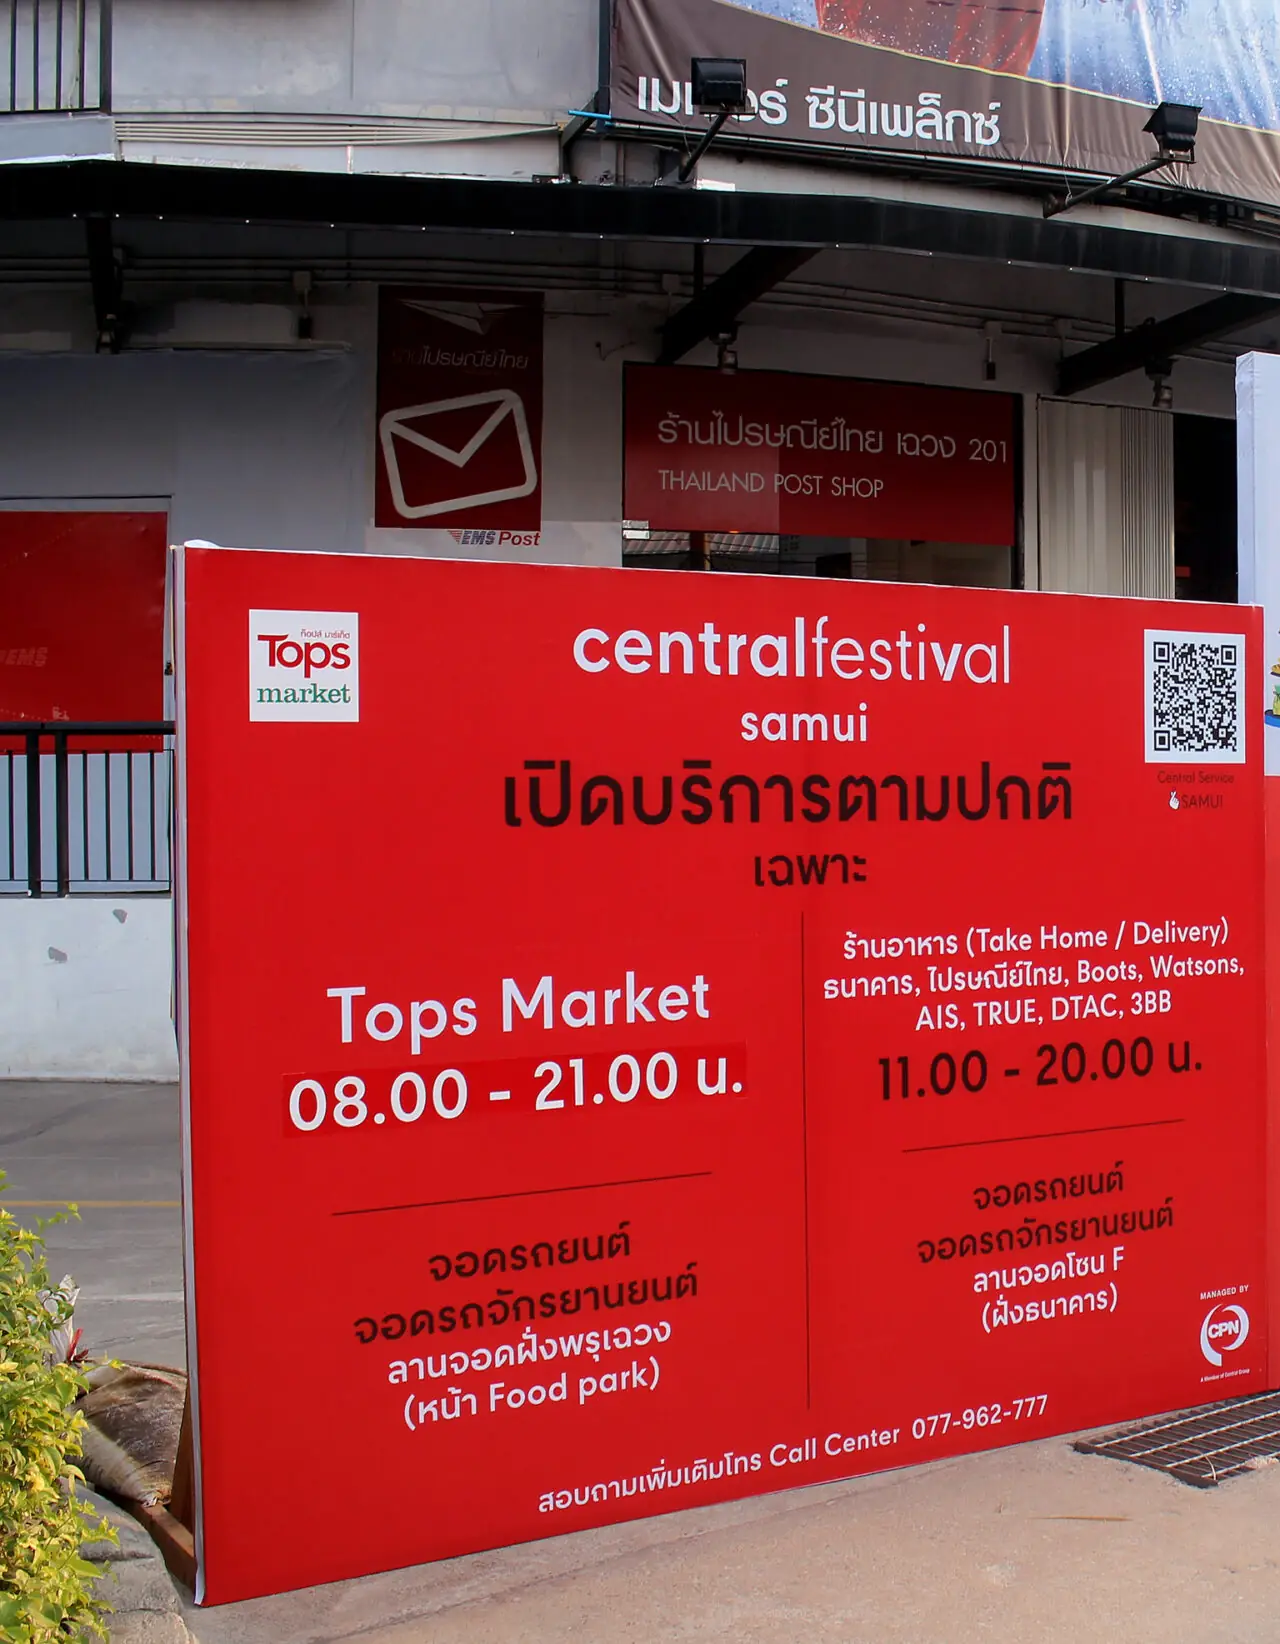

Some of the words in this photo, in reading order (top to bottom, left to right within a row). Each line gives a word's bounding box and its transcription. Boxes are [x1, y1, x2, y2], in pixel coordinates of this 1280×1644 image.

[806, 86, 1001, 146] ซีนีเพล็กซ์
[657, 410, 884, 454] ร้านไปรษณีย์ไทย
[897, 432, 957, 459] เฉวง
[968, 438, 1008, 465] 201
[658, 469, 765, 493] THAILAND
[773, 473, 824, 496] POST
[831, 475, 885, 499] SHOP
[461, 531, 496, 545] EMS
[498, 531, 541, 546] Post
[5, 646, 48, 668] EMS
[257, 633, 351, 679] Tops
[573, 616, 1011, 684] centralfestival
[257, 683, 351, 703] market
[741, 702, 868, 742] samui
[503, 759, 1072, 827] เปิดบริการตามปกติ
[1157, 771, 1195, 784] Central
[1198, 771, 1235, 784] Service
[1181, 794, 1223, 809] SAMUI
[754, 852, 866, 887] เฉพาะ
[843, 930, 957, 961] ร้านอาหาร
[966, 926, 1033, 958] (Take
[1040, 924, 1108, 950] Home
[1133, 915, 1230, 947] Delivery)
[824, 973, 921, 1001] ธนาคาร,
[928, 959, 1069, 995] ไปรษณีย์ไทย,
[1077, 958, 1143, 986] Boots,
[1150, 954, 1246, 979] Watsons,
[327, 985, 477, 1055] Tops
[502, 971, 710, 1033] Market
[915, 1003, 966, 1032] AIS,
[973, 997, 1043, 1027] TRUE,
[1051, 993, 1124, 1021] DTAC,
[1130, 989, 1172, 1014] 3BB
[288, 1068, 468, 1132] 08.00
[490, 1090, 511, 1101] -
[534, 1051, 678, 1111] 21.00
[697, 1057, 743, 1096] น.
[878, 1049, 988, 1100] 11.00
[1036, 1036, 1154, 1087] 20.00
[1167, 1039, 1203, 1073] น.
[973, 1160, 1125, 1211] จอดรถยนต์
[428, 1220, 631, 1282] จอดรถยนต์
[917, 1197, 1175, 1264] จอดรถจักรยานยนต์
[972, 1251, 1106, 1293] ลานจอดโซน
[1112, 1246, 1125, 1271] F
[1200, 1286, 1237, 1300] MANAGED
[1239, 1284, 1249, 1293] BY
[353, 1261, 699, 1345] จอดรถจักรยานยนต์
[981, 1282, 1119, 1333] (ฝั่งธนาคาร)
[387, 1319, 673, 1385] ลานจอดฝั่งพรุเฉวง
[1208, 1319, 1240, 1340] CPN
[404, 1387, 478, 1431] (หน้า
[489, 1374, 568, 1412] Food
[579, 1356, 662, 1406] park)
[538, 1451, 763, 1513] สอบถามเพิ่มเติมโทร
[769, 1438, 817, 1468] Call
[824, 1426, 901, 1457] Center
[911, 1395, 1048, 1441] 077-962-777
